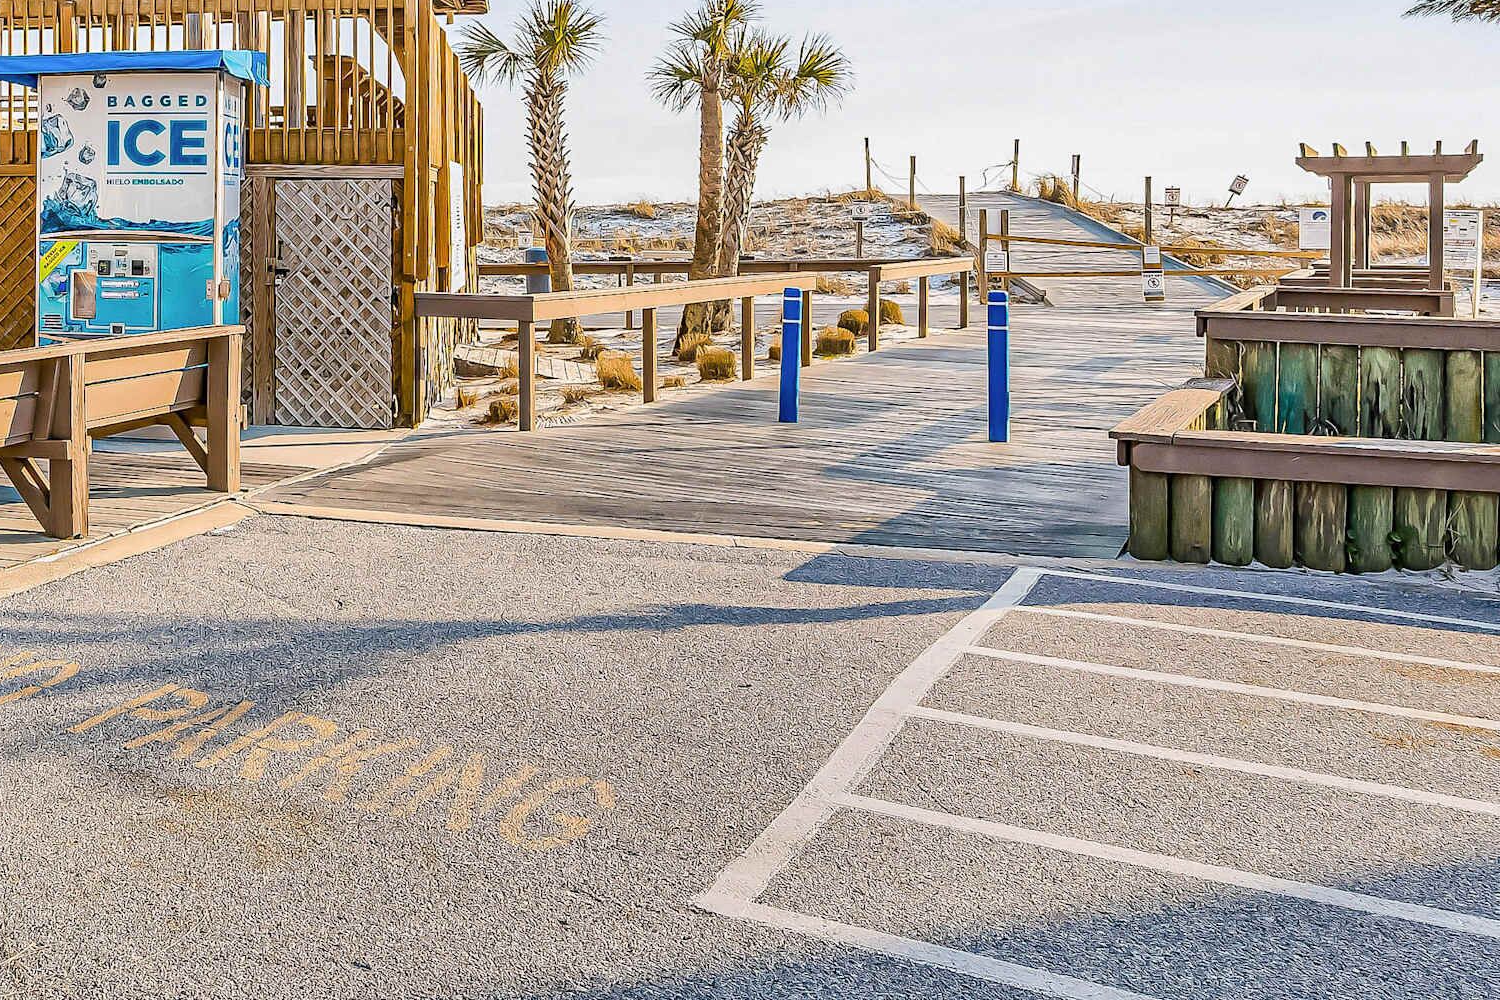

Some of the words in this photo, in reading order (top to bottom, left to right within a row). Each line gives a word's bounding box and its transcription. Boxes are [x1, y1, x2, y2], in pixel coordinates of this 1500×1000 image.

[107, 95, 207, 108] BAGGED
[107, 119, 207, 166] ICE
[65, 684, 615, 851] PARKING
